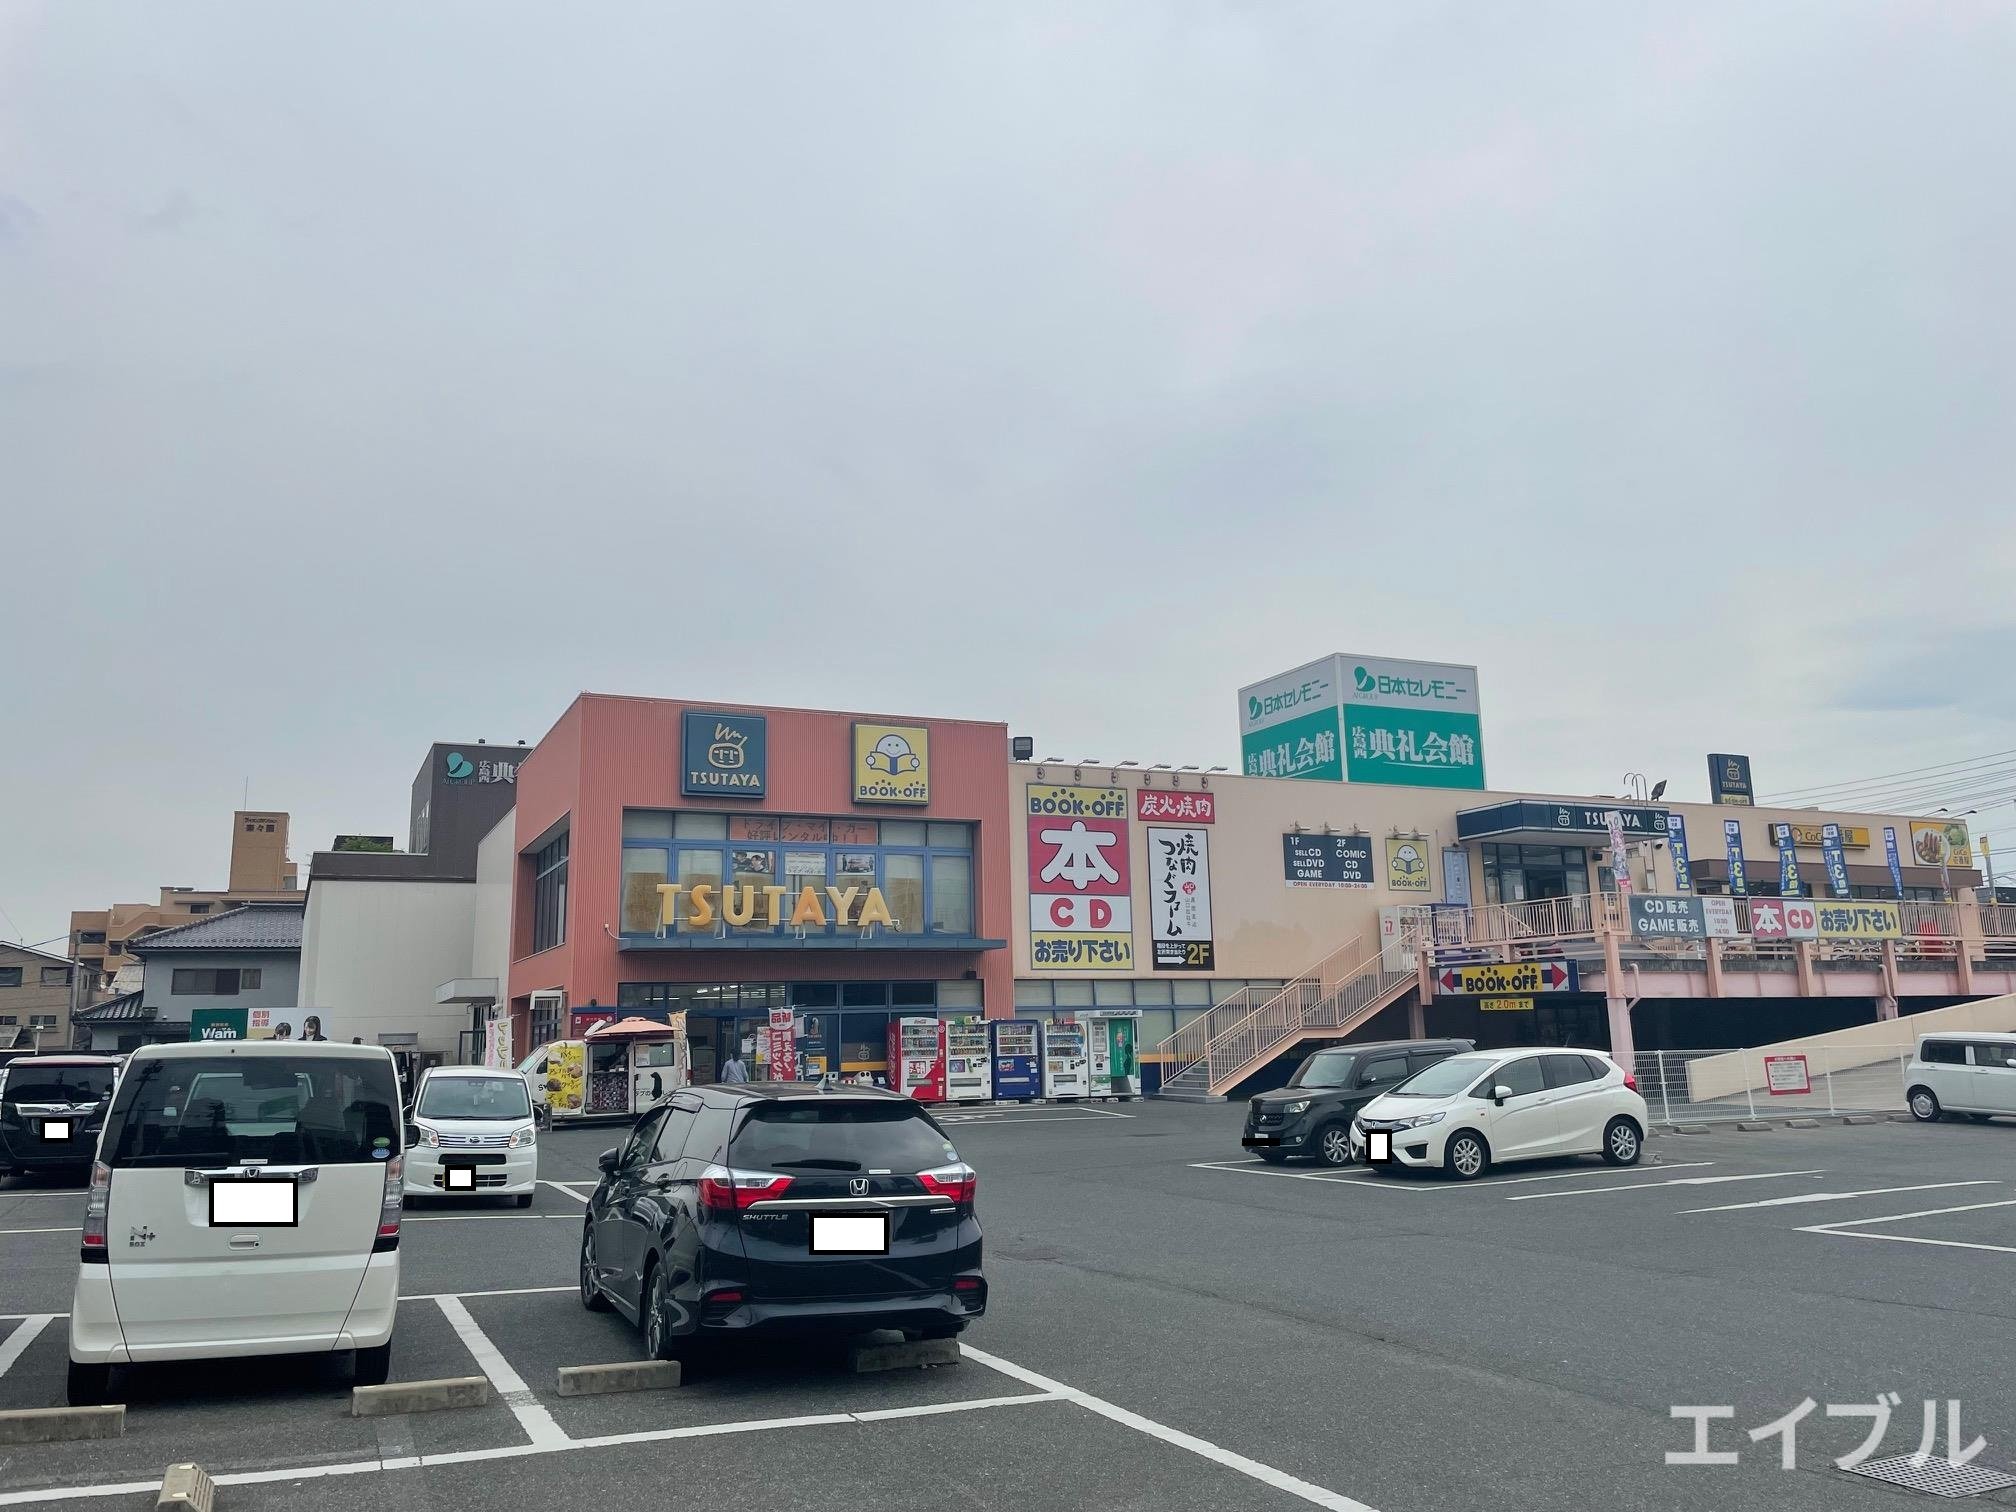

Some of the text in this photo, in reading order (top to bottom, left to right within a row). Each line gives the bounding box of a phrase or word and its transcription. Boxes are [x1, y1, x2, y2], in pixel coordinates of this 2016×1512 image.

[1264, 680, 1328, 715] 日本セレモニー
[1378, 675, 1466, 700] 日本セレモニー
[1259, 731, 1334, 776] 典礼会館
[1369, 729, 1474, 765] 典礼会館
[490, 761, 518, 784] 典
[691, 771, 760, 788] TSUTAYA
[1722, 781, 1747, 789] TSUTAYA
[1141, 795, 1212, 818] 炭火焼肉
[1290, 837, 1299, 846] 1F
[1337, 839, 1346, 847] 2F
[1805, 830, 1823, 842] CoC
[1040, 820, 1119, 890] 本
[1176, 833, 1198, 875] 焼肉
[1336, 849, 1366, 859] COMIC
[1345, 860, 1358, 869] CD
[1297, 869, 1323, 878] GAME
[1343, 870, 1361, 879] DVD
[1158, 839, 1182, 936] つなぐファーム
[656, 884, 893, 927] TSUTAYA
[1050, 898, 1112, 928] CD
[1644, 901, 1689, 915] CD 販売
[1638, 918, 1699, 933] GAME 販売
[1753, 904, 1782, 934] 本
[1787, 908, 1814, 929] CD
[1820, 908, 1897, 932] お売り下さい
[1035, 939, 1130, 963] お売り下さい
[1187, 943, 1210, 965] 2F
[1497, 1000, 1516, 1009] 2.0m
[1518, 1000, 1529, 1008] まで
[202, 1028, 237, 1038] Wam
